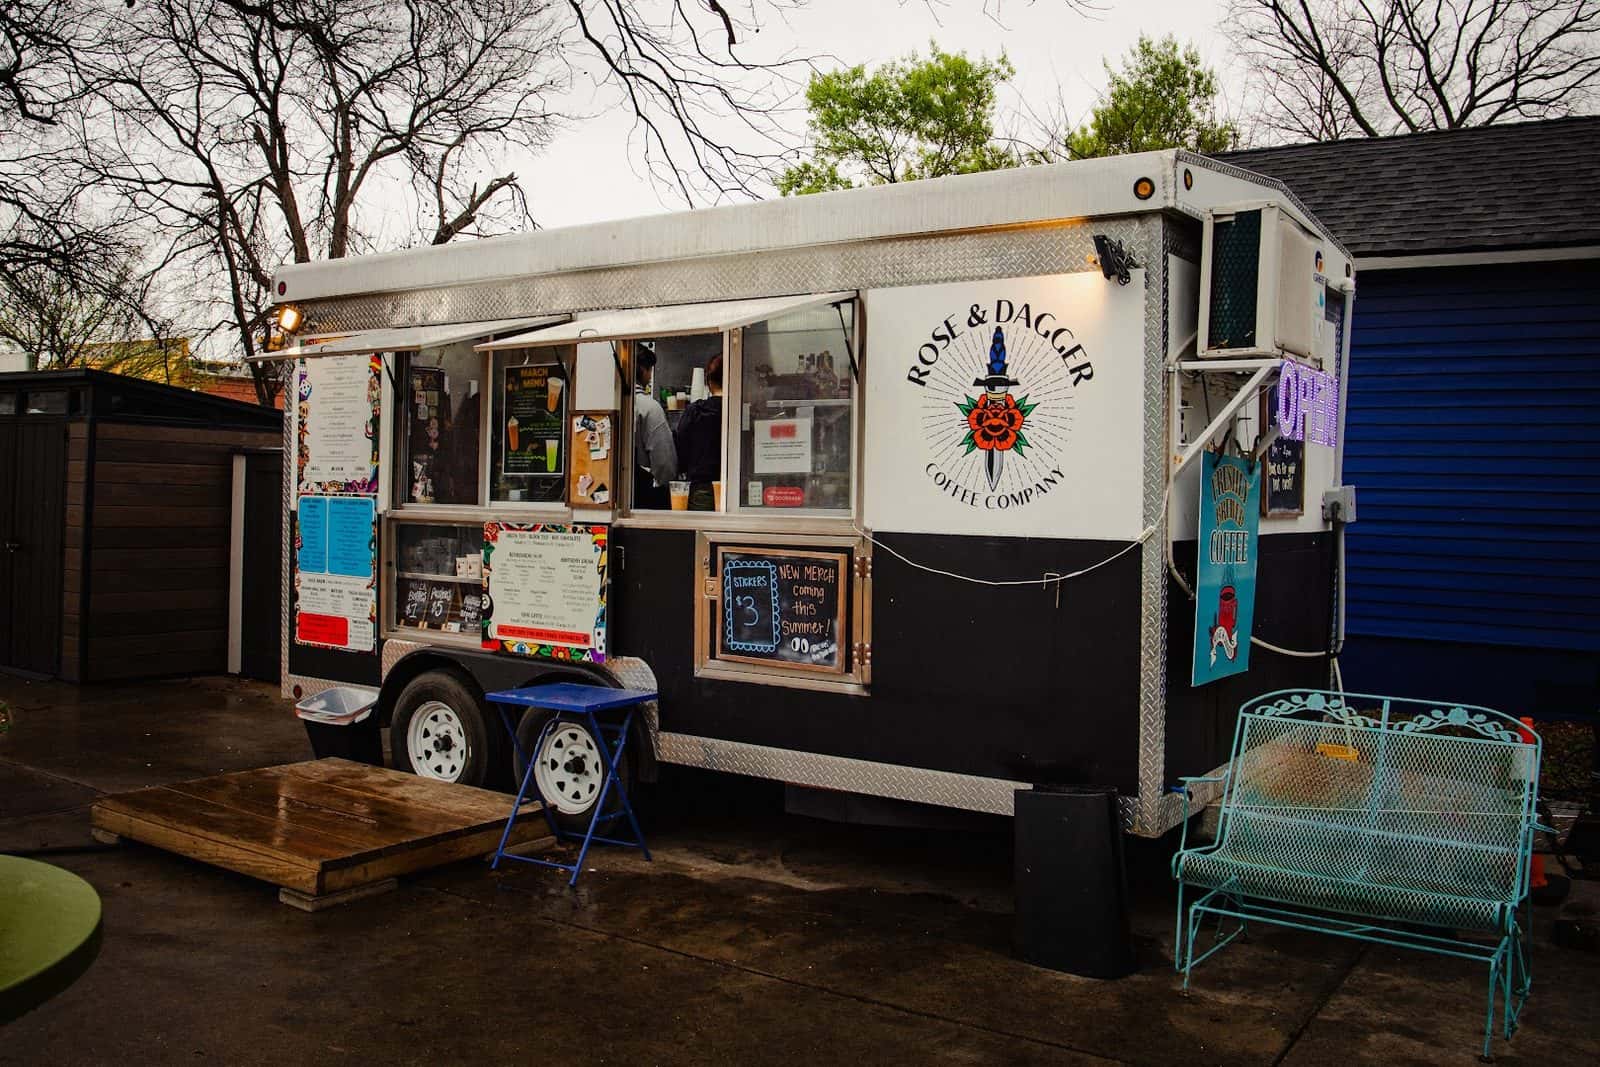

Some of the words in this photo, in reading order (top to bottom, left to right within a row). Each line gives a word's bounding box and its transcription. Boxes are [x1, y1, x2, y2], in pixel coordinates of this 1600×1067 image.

[907, 313, 964, 387] ROSE
[967, 303, 987, 328] &
[995, 299, 1095, 387] DAGGER
[1279, 361, 1339, 448] OPEN
[926, 462, 981, 507] COFFEE
[985, 464, 1066, 510] COMPANY
[1211, 464, 1250, 504] FRESHLY
[1215, 498, 1244, 528] BREWED
[1209, 529, 1249, 564] COFFEE
[734, 575, 768, 588] STICKERS
[779, 564, 801, 581] NEW
[803, 565, 836, 584] MERCH
[431, 600, 445, 617] $5
[735, 595, 760, 627] $3
[792, 600, 817, 617] this
